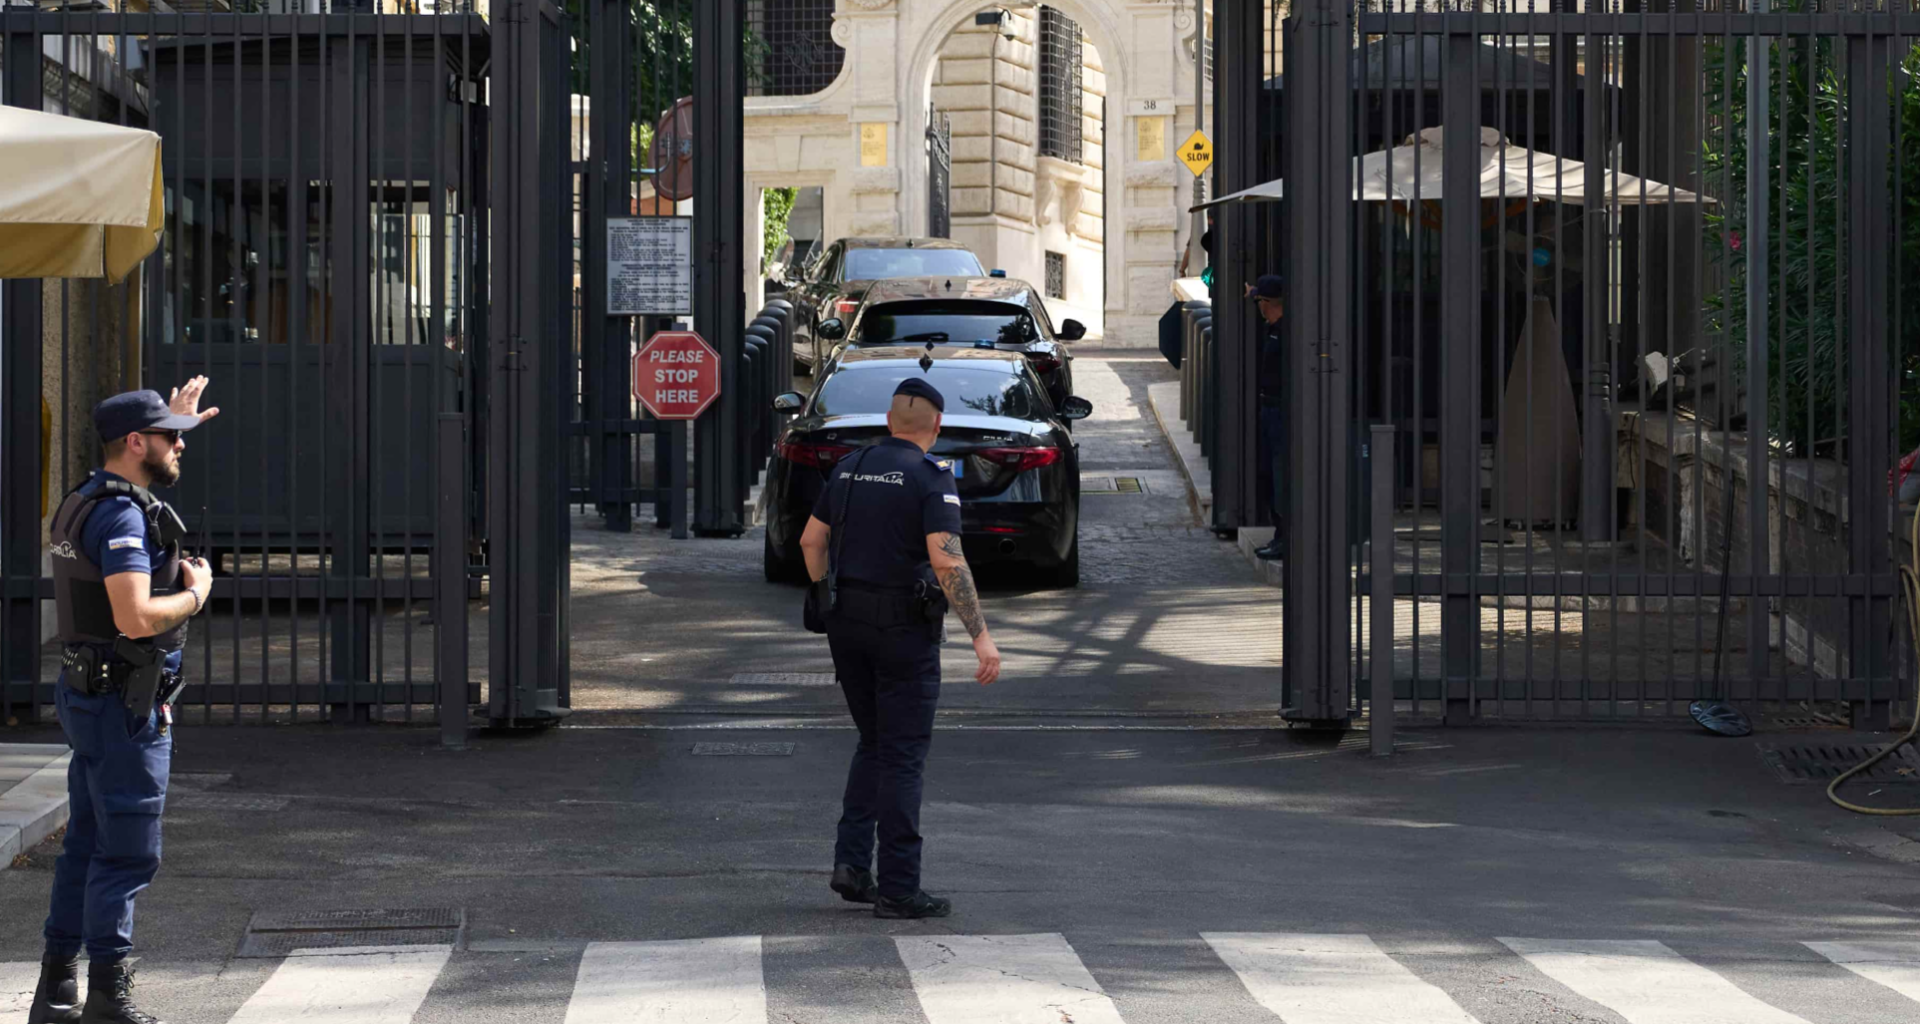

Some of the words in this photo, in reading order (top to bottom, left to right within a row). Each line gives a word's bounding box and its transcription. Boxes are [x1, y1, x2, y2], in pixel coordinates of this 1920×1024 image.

[1143, 100, 1157, 110] 38
[1186, 152, 1210, 162] SLOW
[649, 350, 704, 364] PLEASE
[654, 369, 699, 384] STOP
[655, 389, 699, 404] HERE
